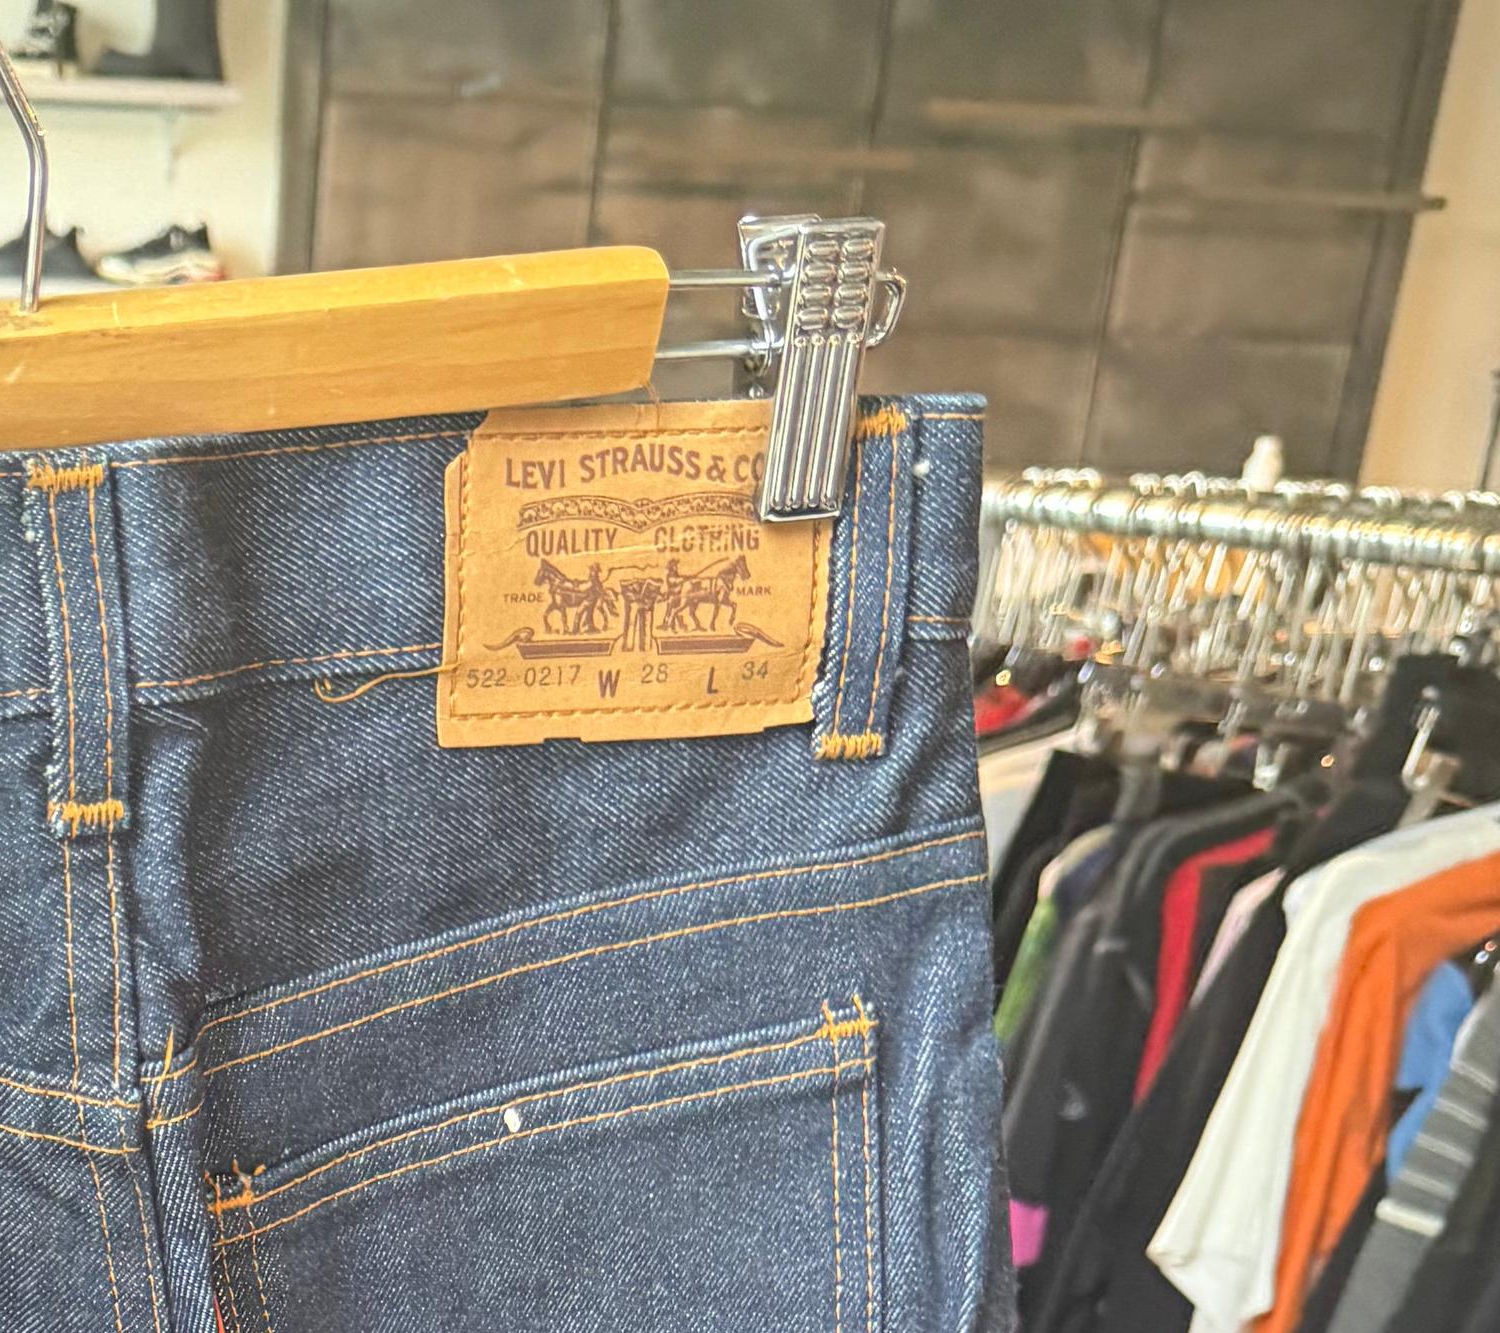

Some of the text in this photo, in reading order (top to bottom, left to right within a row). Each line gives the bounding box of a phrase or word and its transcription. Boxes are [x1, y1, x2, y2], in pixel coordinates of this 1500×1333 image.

[505, 457, 566, 490] LEVI
[578, 443, 701, 484] STRAUSS
[705, 454, 727, 483] &
[526, 523, 760, 557] QUALITY CLOTHING
[502, 592, 545, 604] TRADE
[735, 585, 772, 597] MARK
[598, 668, 621, 699] W
[706, 666, 719, 695] L
[741, 660, 769, 680] 34
